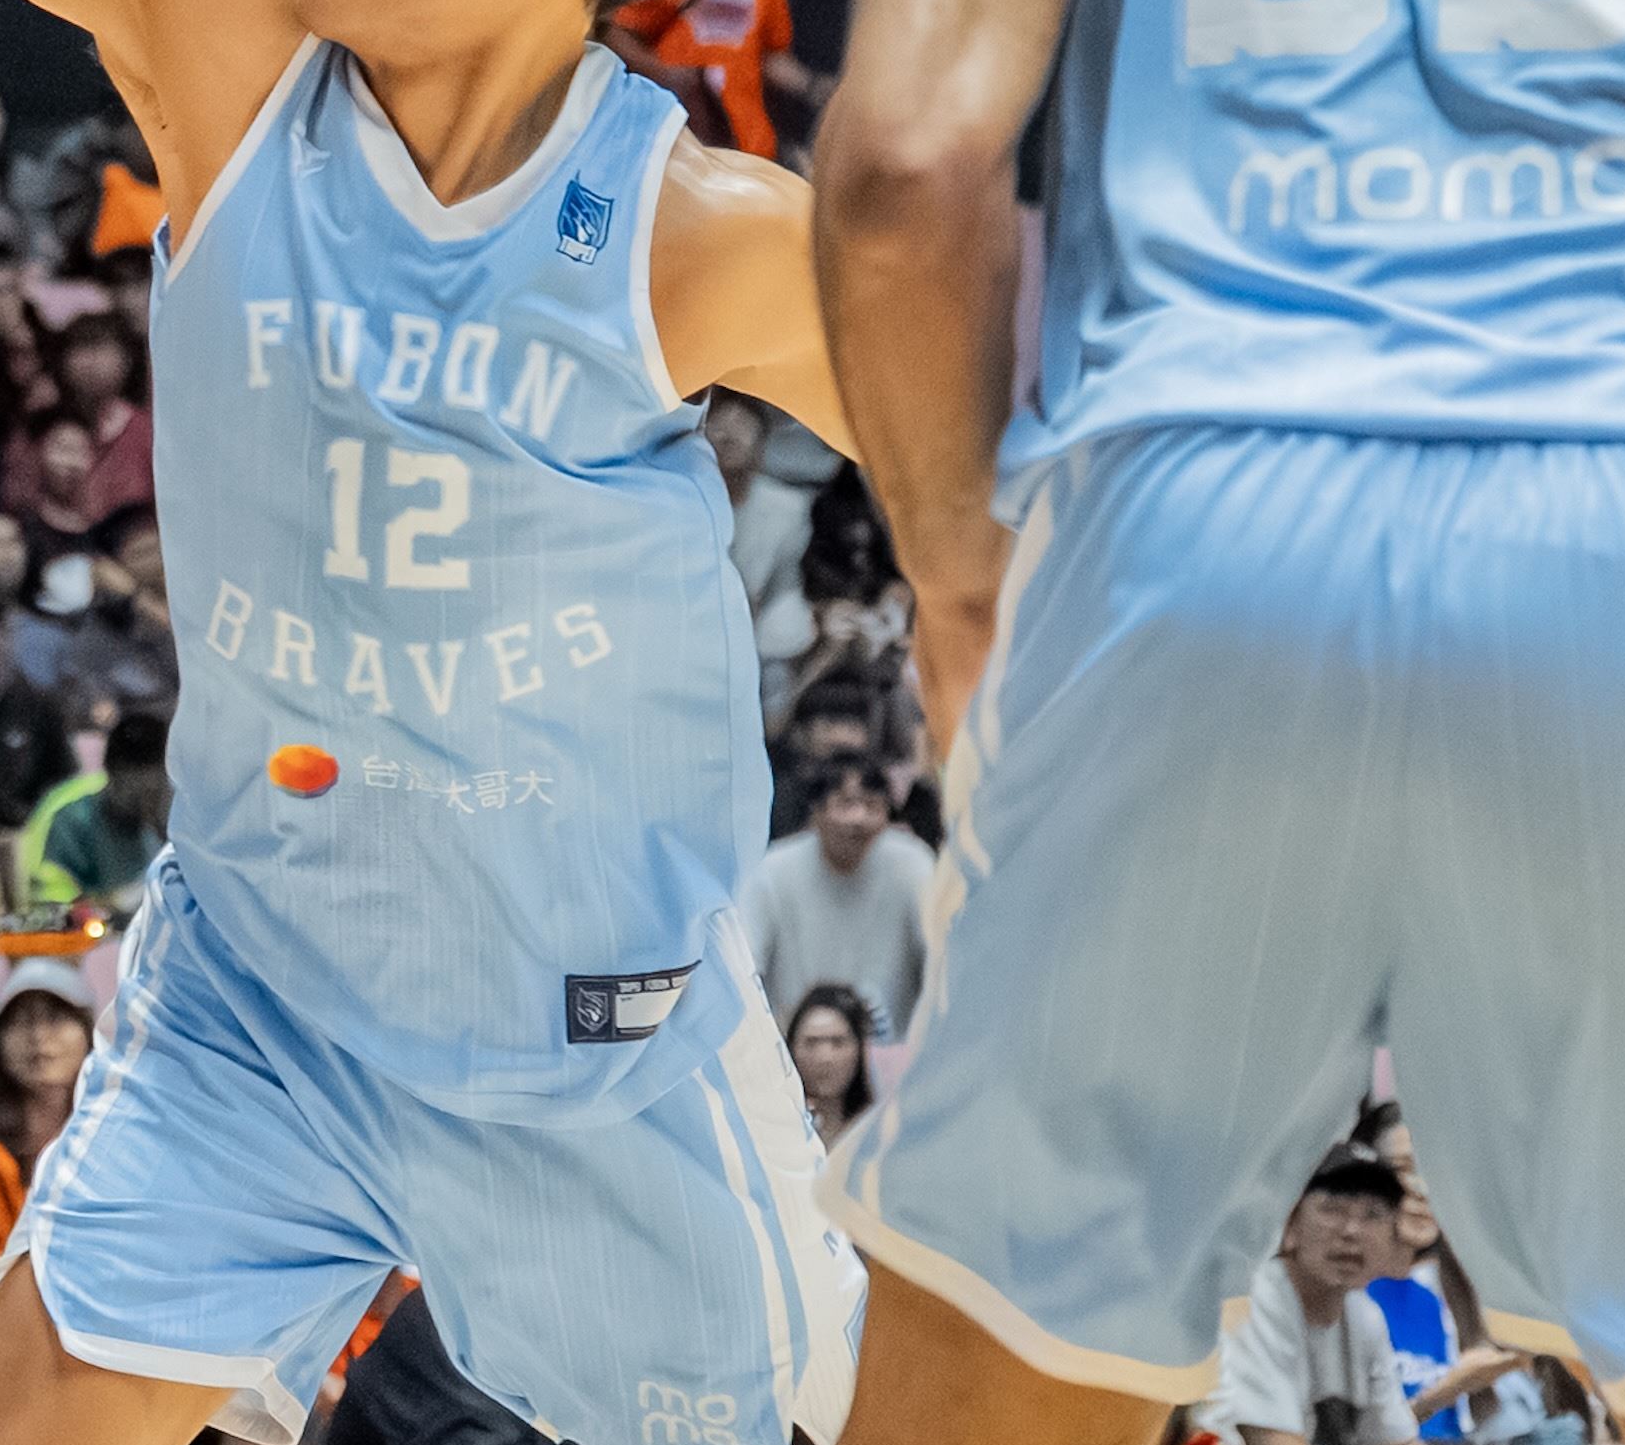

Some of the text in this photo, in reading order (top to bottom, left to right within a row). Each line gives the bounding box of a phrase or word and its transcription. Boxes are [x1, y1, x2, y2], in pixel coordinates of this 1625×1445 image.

[243, 297, 578, 441] FUBON
[322, 440, 474, 591] 12
[206, 579, 614, 717] BRAVES
